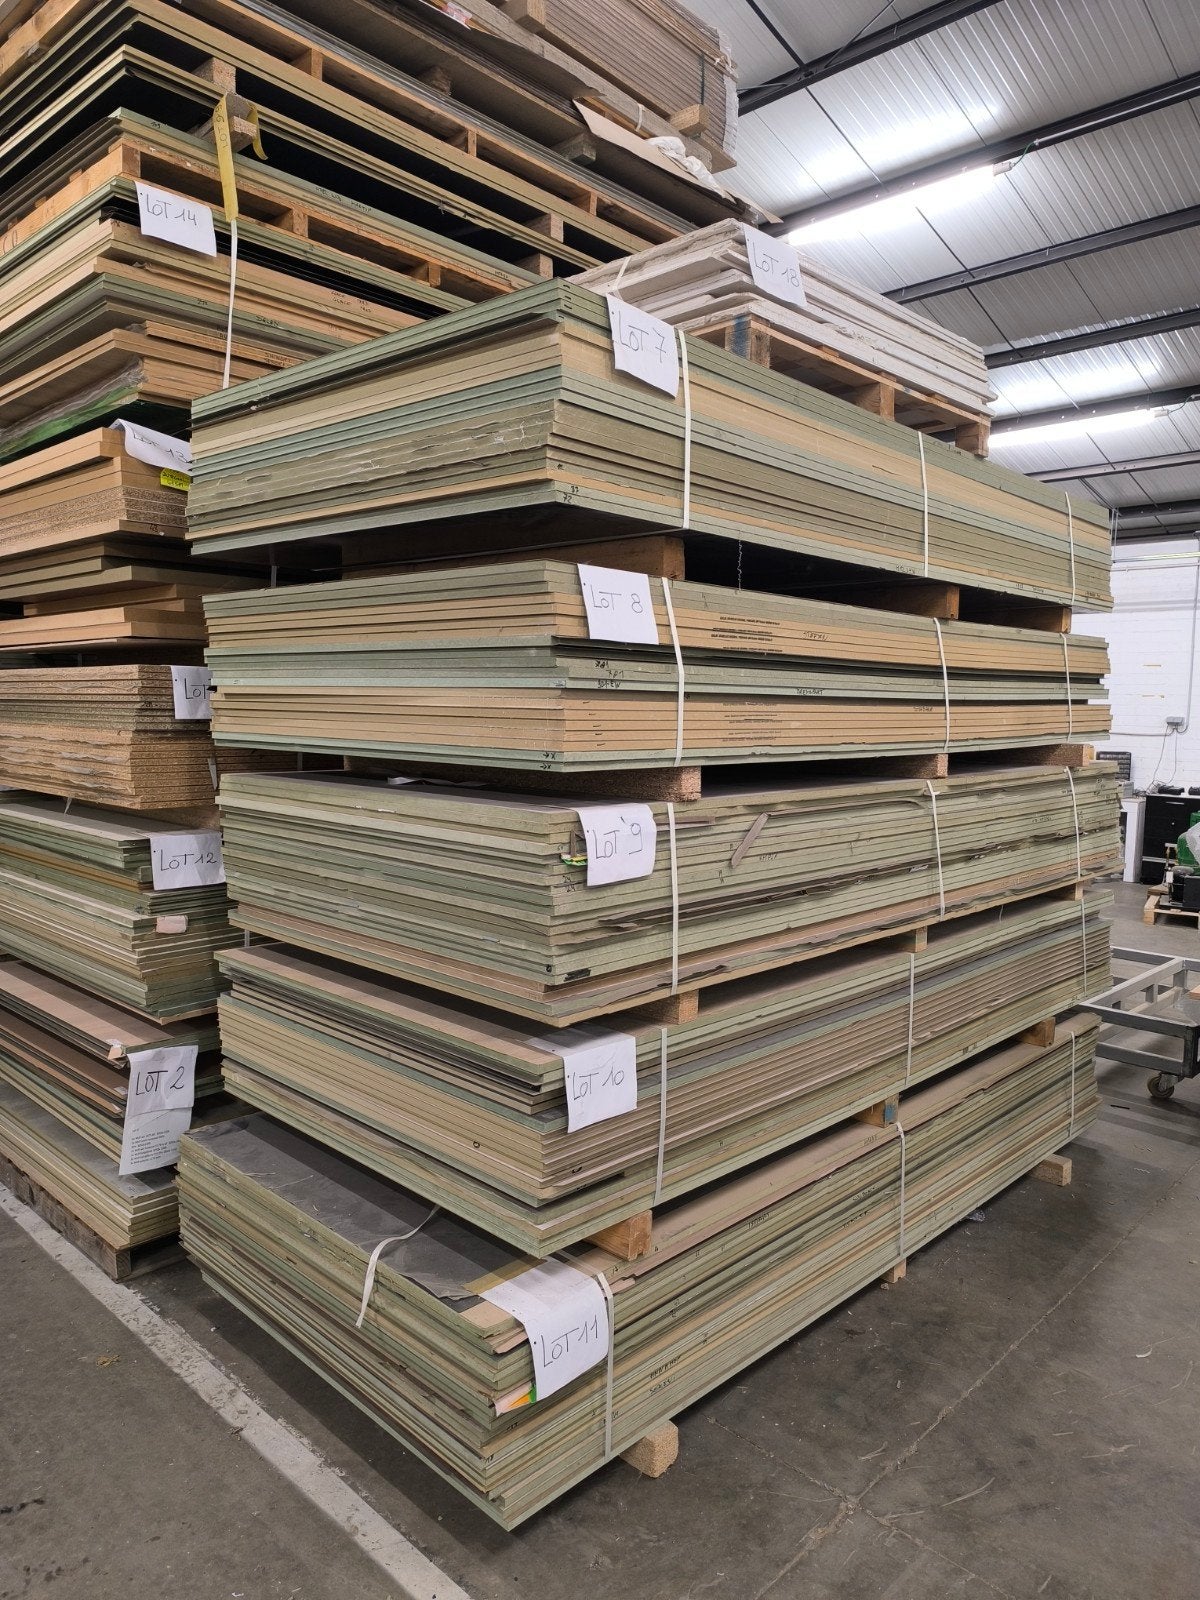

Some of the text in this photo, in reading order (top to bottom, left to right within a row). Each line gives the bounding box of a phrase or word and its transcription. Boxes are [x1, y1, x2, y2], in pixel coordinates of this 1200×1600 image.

[146, 193, 197, 226] LOT 14
[752, 241, 800, 288] LOT 18
[618, 310, 667, 363] LOT 7
[590, 584, 644, 614] LOT 8
[184, 677, 212, 700] LOT
[592, 822, 644, 859] LOT 9
[160, 848, 218, 872] LOT 12
[135, 1065, 185, 1096] LOT 2
[572, 1065, 625, 1101] LOT 10
[540, 1314, 599, 1368] LOT 11
